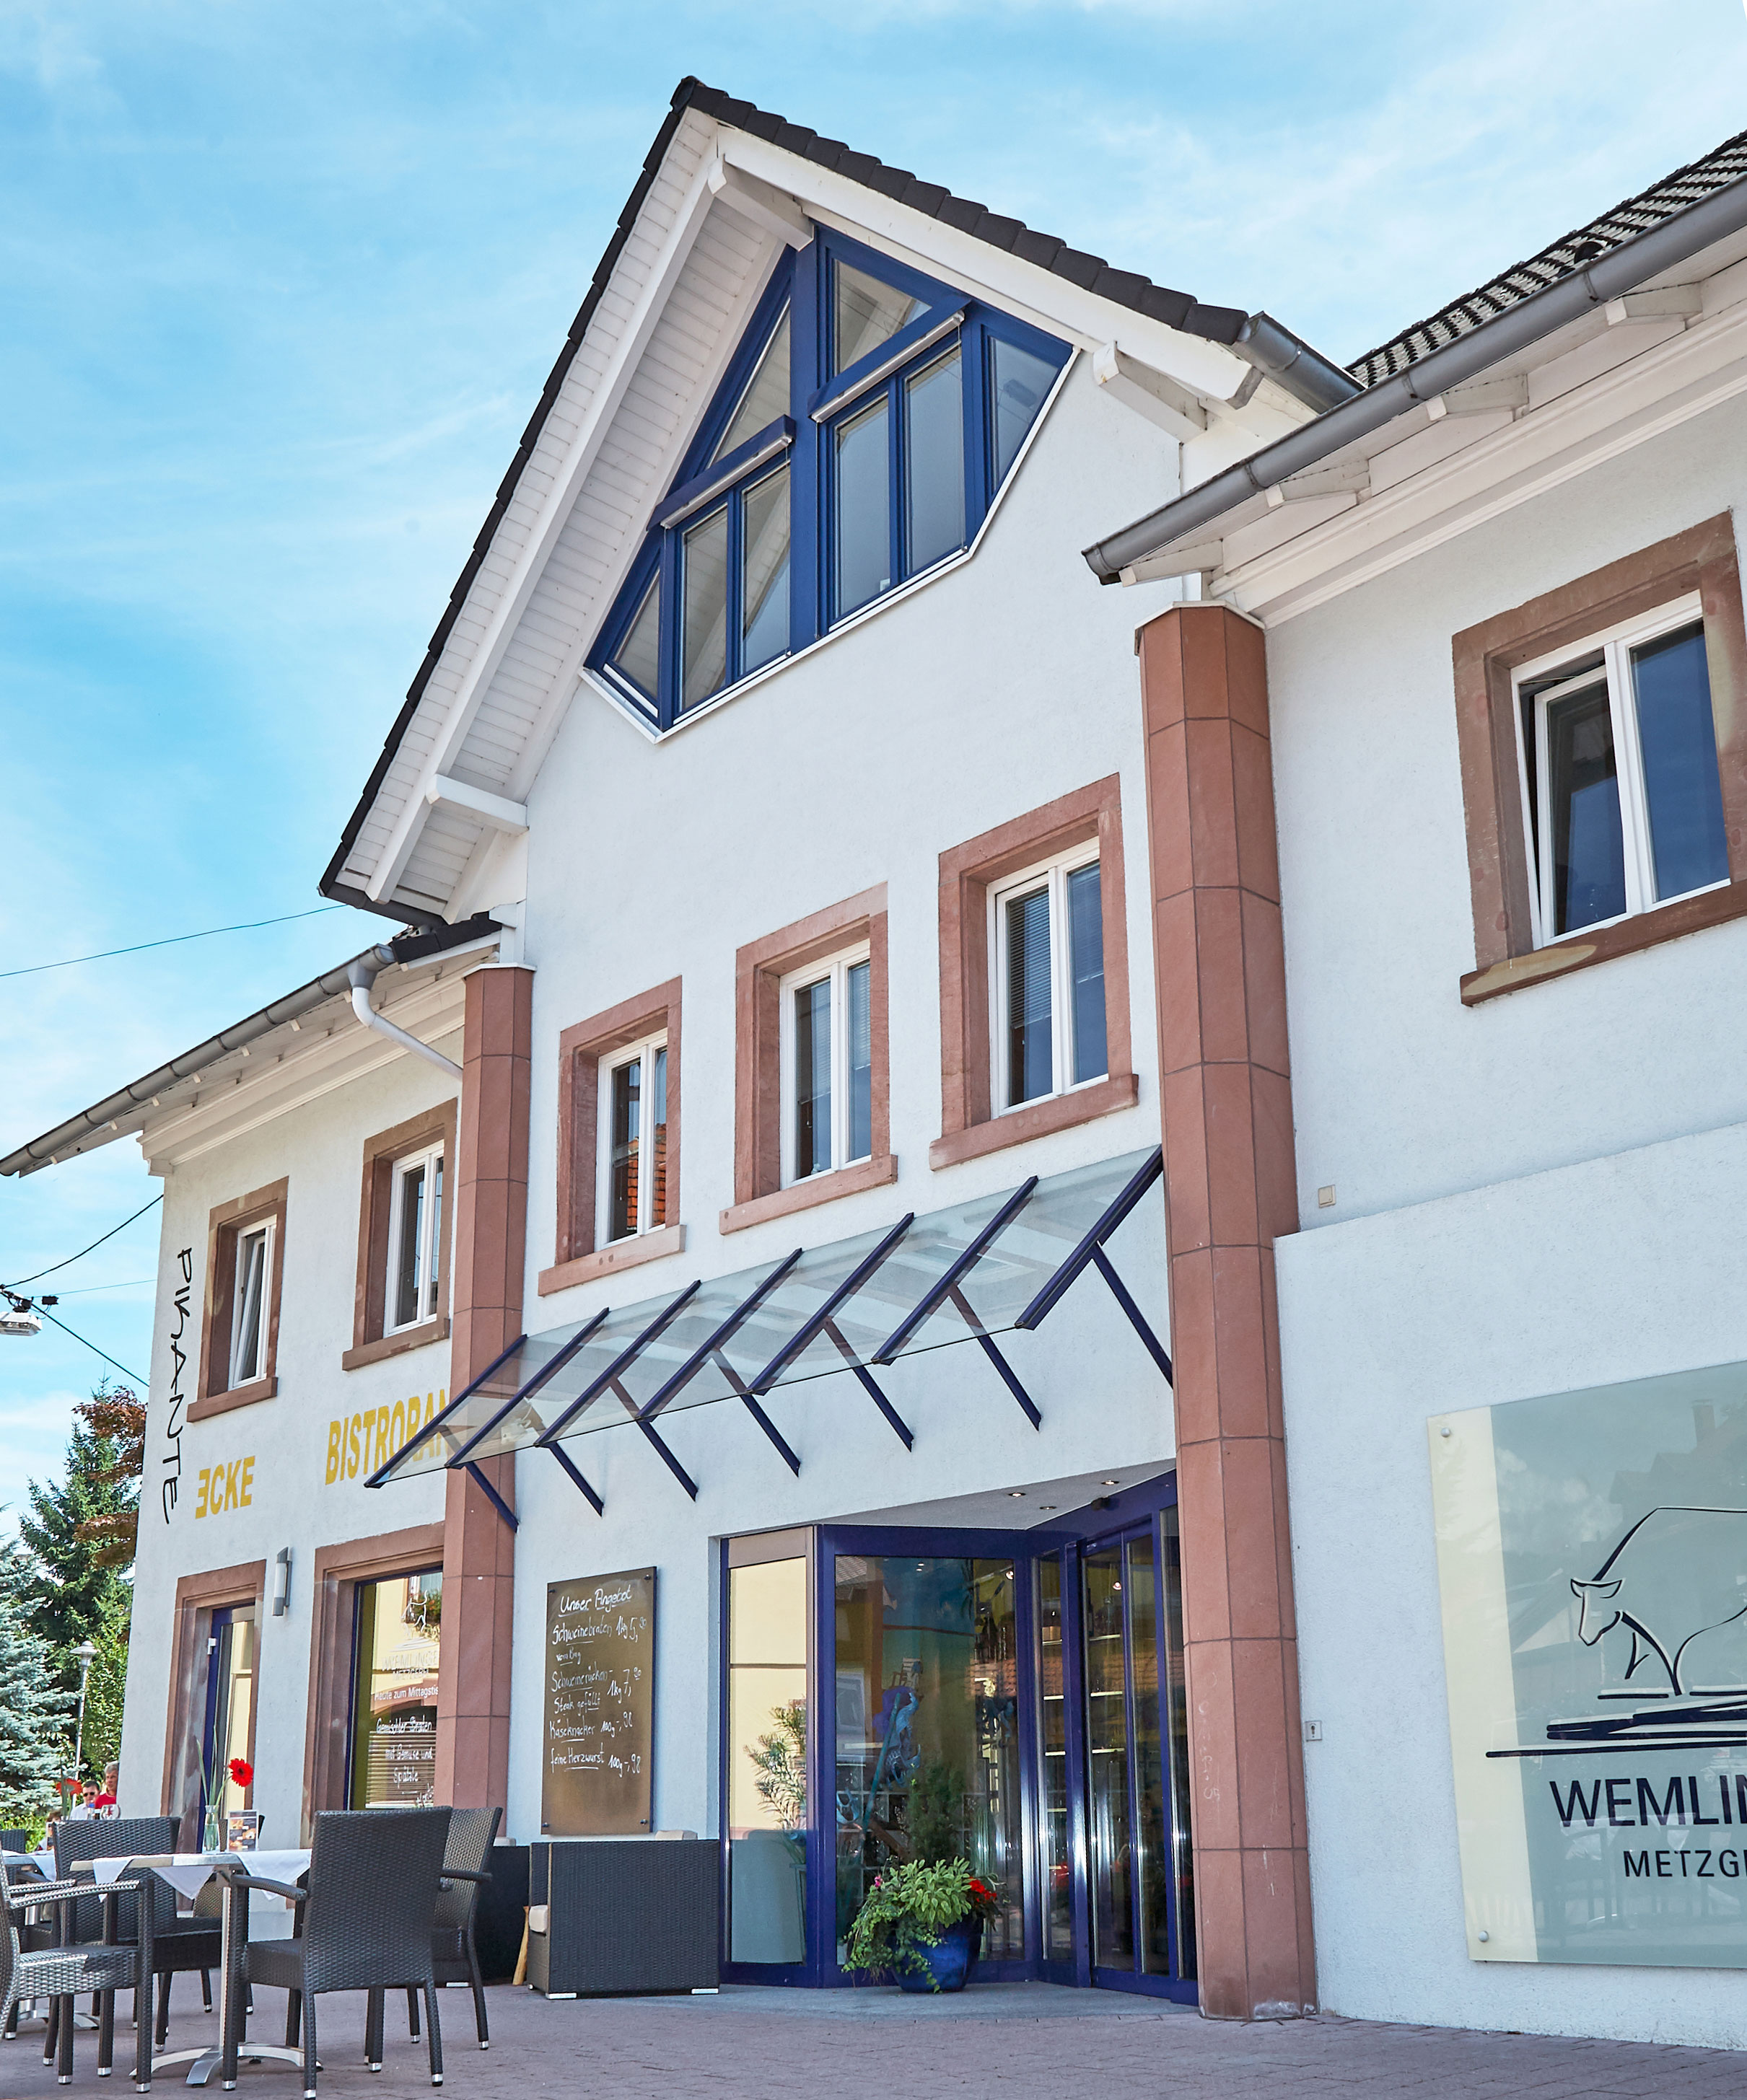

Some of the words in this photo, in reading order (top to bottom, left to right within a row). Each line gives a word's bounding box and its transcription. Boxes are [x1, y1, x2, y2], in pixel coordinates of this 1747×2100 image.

[162, 1247, 193, 1524] PIKANTE
[195, 1455, 256, 1519] ECKE
[560, 1596, 592, 1613] Unser
[595, 1584, 632, 1612] Angebot
[552, 1615, 612, 1645] Schweinebraten
[393, 1690, 407, 1700] zum
[554, 1695, 574, 1714] Steak
[1549, 1775, 1747, 1827] WEMLI
[1624, 1850, 1747, 1878] METZG
